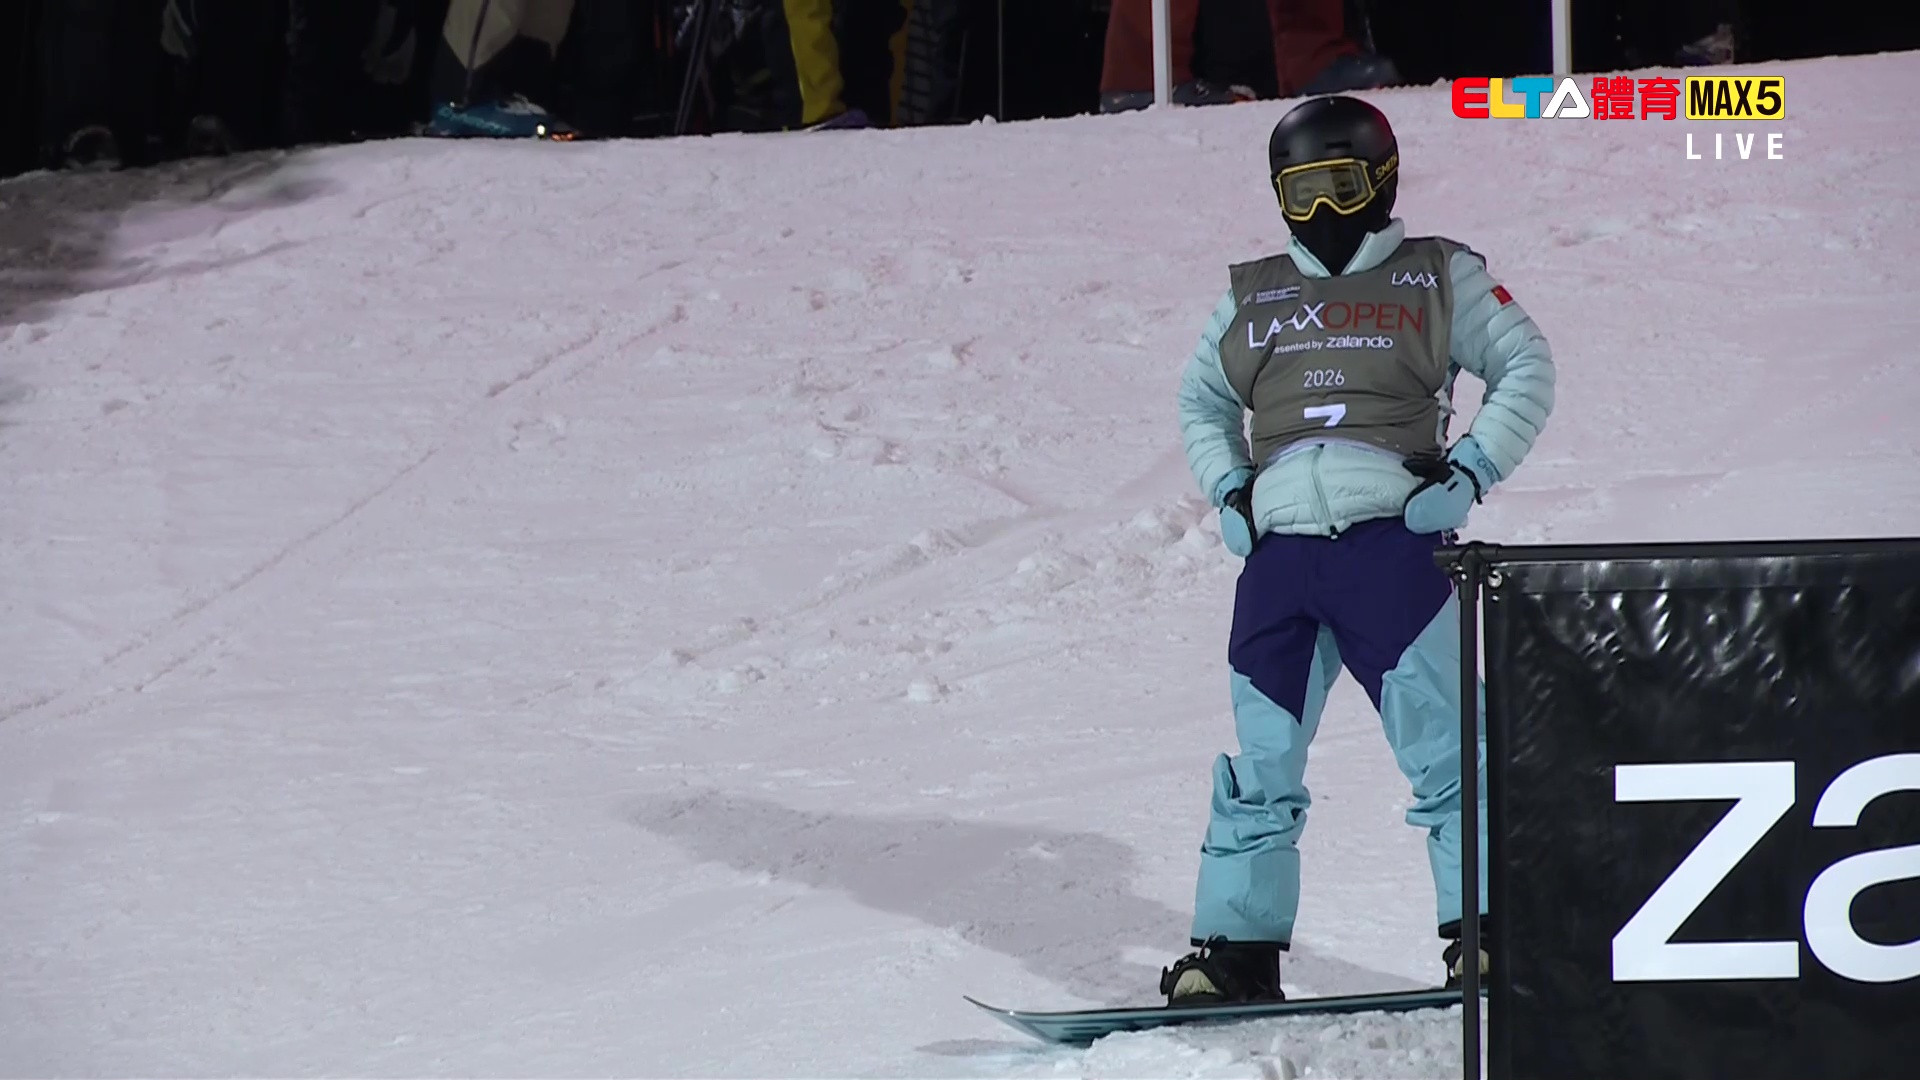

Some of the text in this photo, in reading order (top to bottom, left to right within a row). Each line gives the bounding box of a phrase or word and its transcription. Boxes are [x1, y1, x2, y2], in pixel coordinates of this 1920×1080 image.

[1390, 271, 1438, 288] LAAX
[1311, 339, 1323, 350] by
[1326, 334, 1394, 349] zalando
[1303, 369, 1345, 388] 2026
